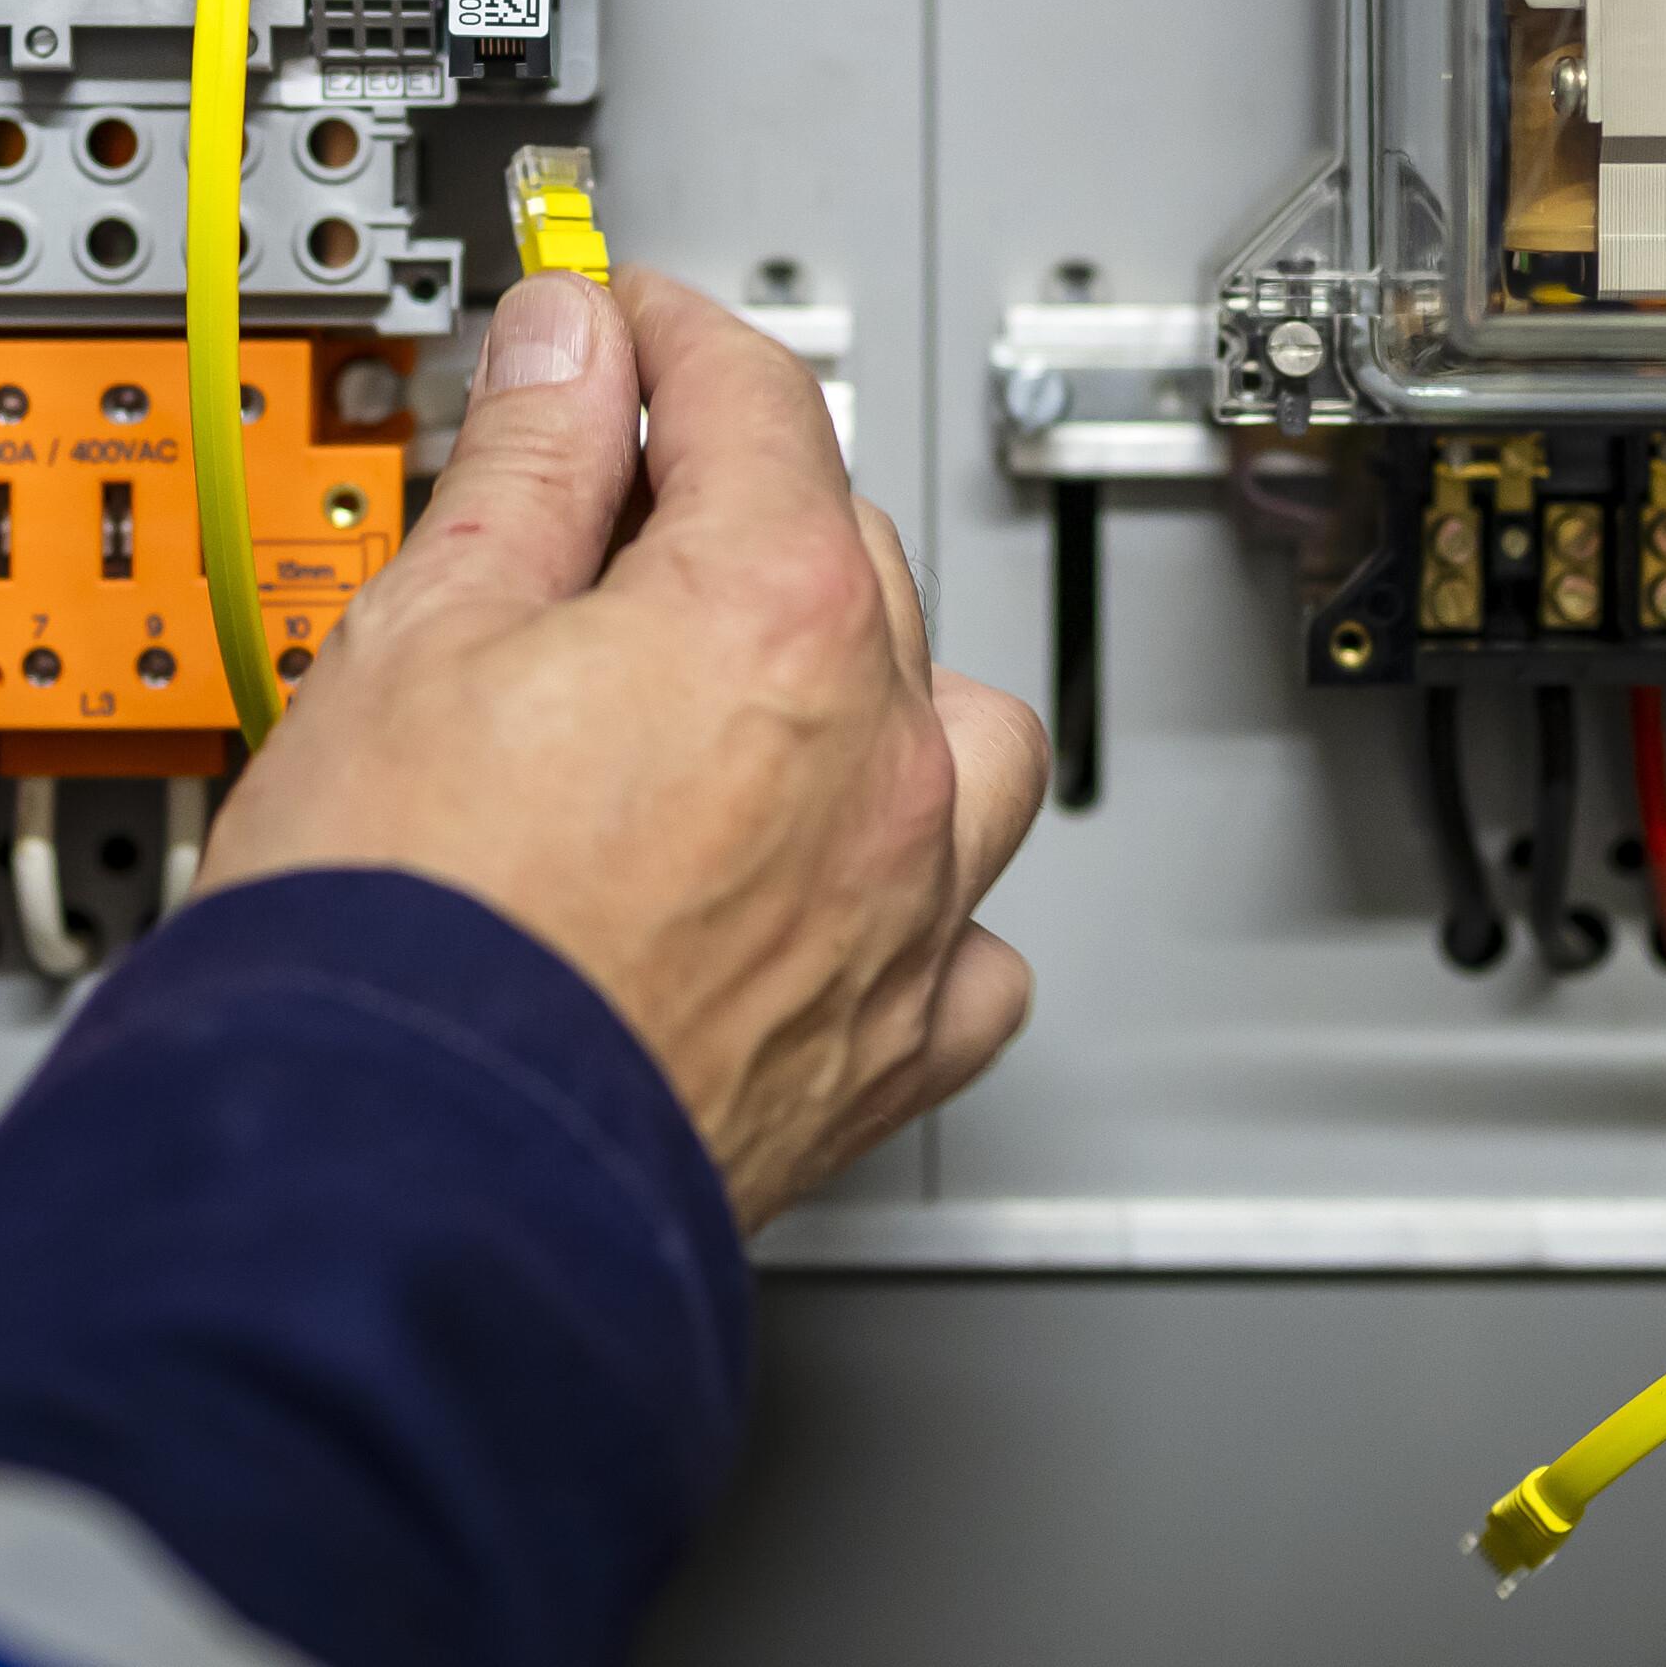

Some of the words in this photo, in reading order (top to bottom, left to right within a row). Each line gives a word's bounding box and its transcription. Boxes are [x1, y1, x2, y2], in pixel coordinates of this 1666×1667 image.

[327, 71, 357, 91] E2
[369, 71, 399, 91] E0
[49, 438, 59, 466] /
[71, 440, 178, 464] 400VAC
[33, 617, 48, 638] 7
[148, 616, 163, 638] 9
[81, 694, 115, 716] L3
